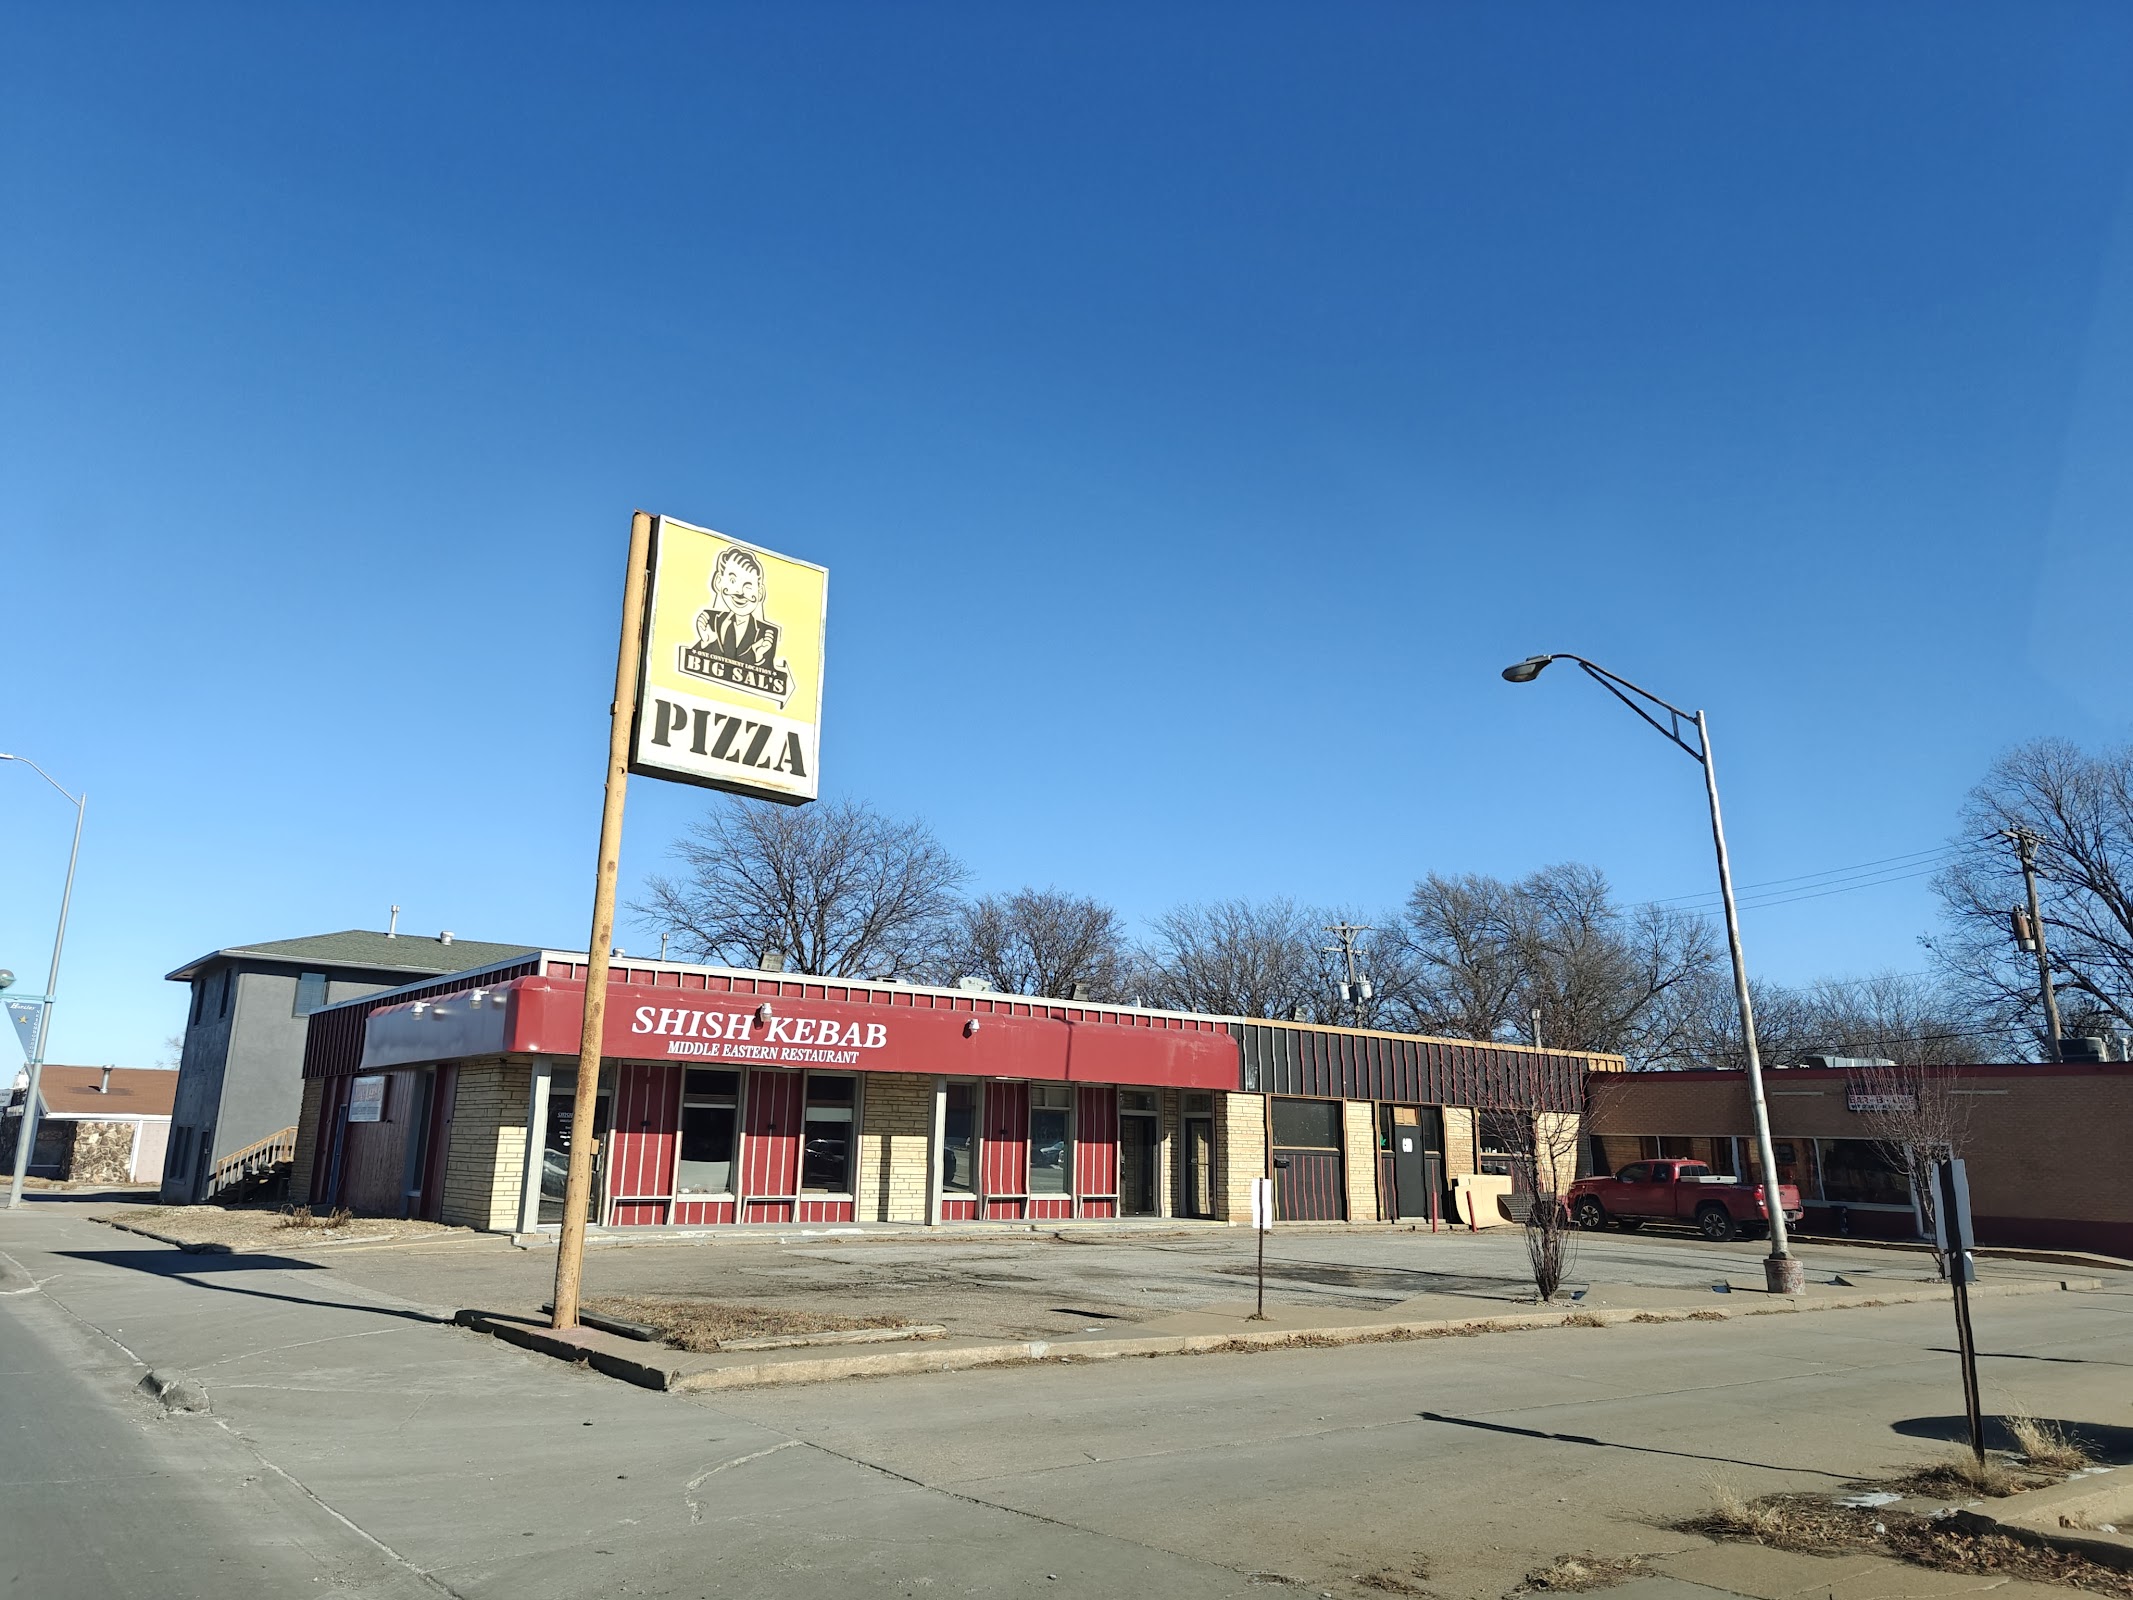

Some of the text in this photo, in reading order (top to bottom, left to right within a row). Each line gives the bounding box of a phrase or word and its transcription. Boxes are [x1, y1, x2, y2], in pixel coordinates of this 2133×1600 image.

[687, 654, 784, 693] BIG SAL'S
[698, 650, 772, 676] ONE CONVENIENT LOCATION
[650, 698, 807, 778] PIZZA
[631, 1006, 887, 1048] SHISH KEBAB
[667, 1040, 859, 1064] MIDDLE EASTERN RESTAURANT
